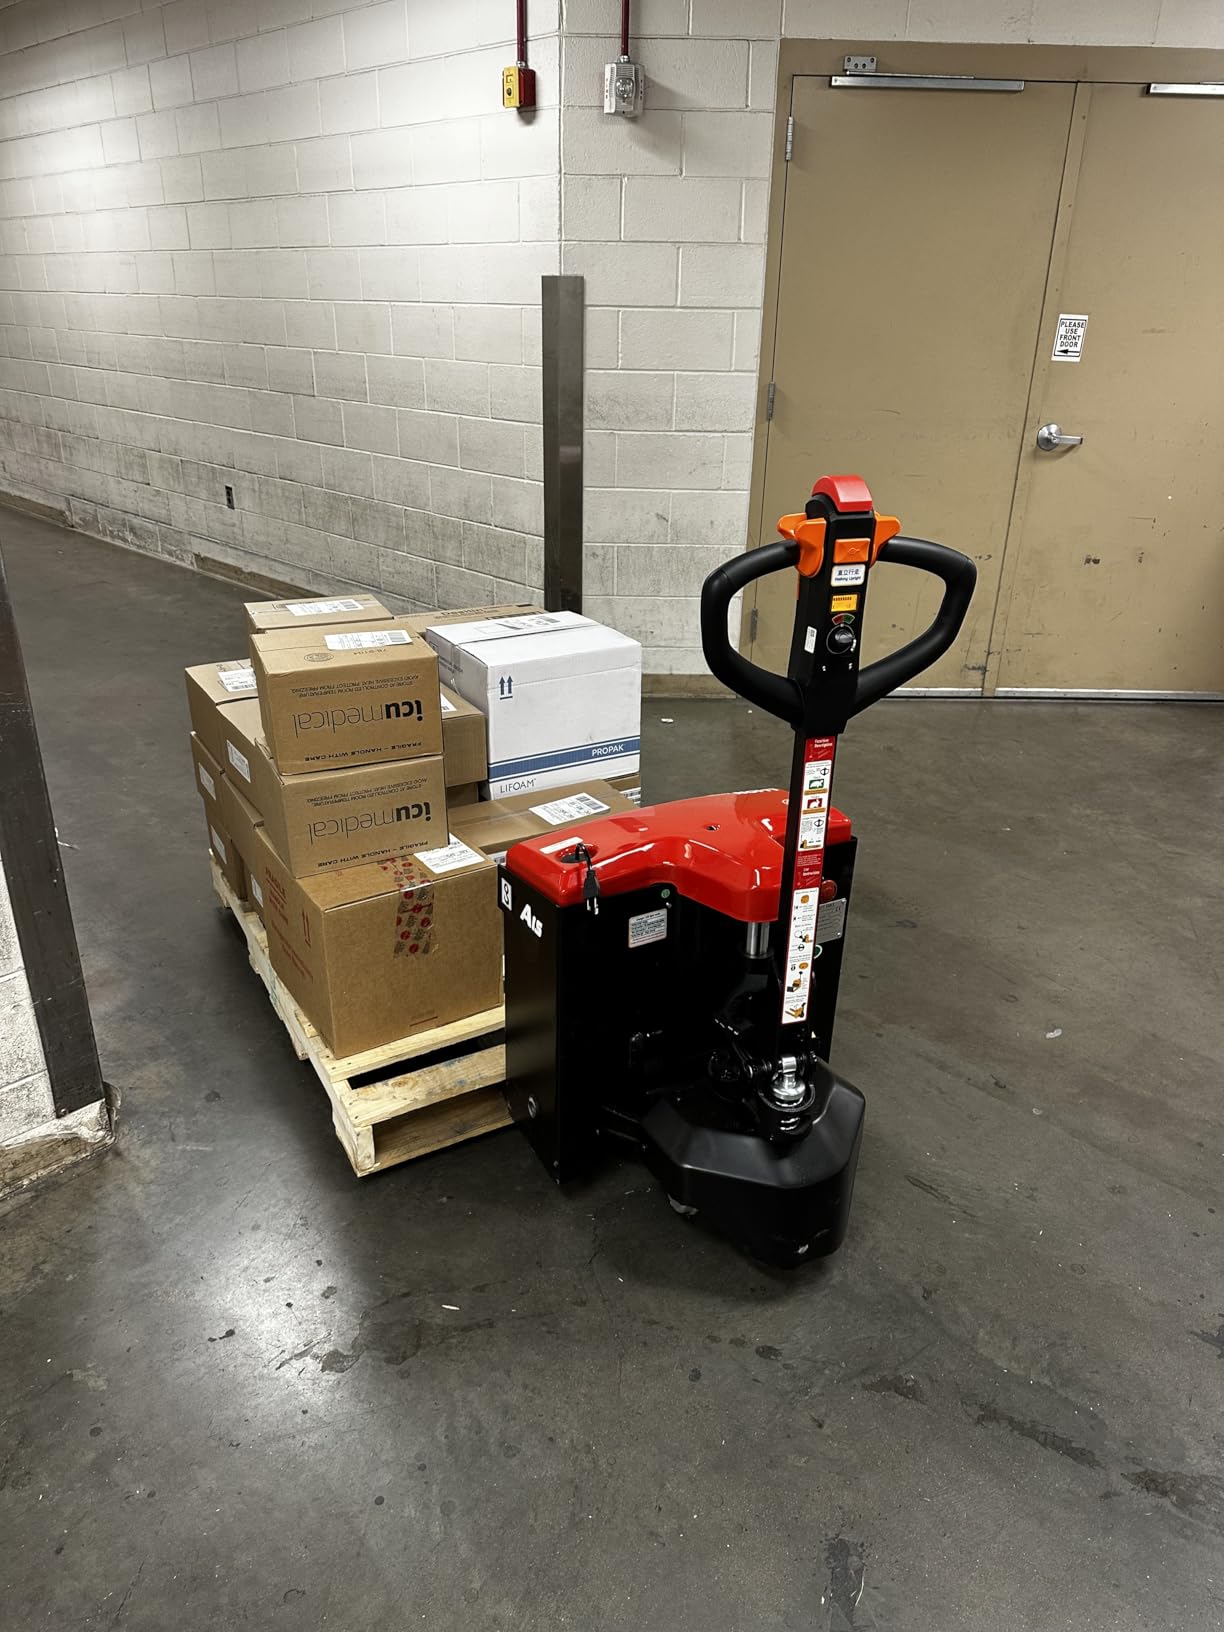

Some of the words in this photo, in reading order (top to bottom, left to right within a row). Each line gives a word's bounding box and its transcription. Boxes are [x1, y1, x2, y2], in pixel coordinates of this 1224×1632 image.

[1059, 334, 1081, 342] FRONT
[391, 742, 422, 750] FRAGILE
[591, 743, 624, 757] PROPAK
[351, 747, 382, 756] HANDLE
[400, 841, 428, 850] FRAGILE
[361, 849, 391, 858] HANDLE
[318, 859, 338, 867] CARE
[340, 855, 360, 863] WITH
